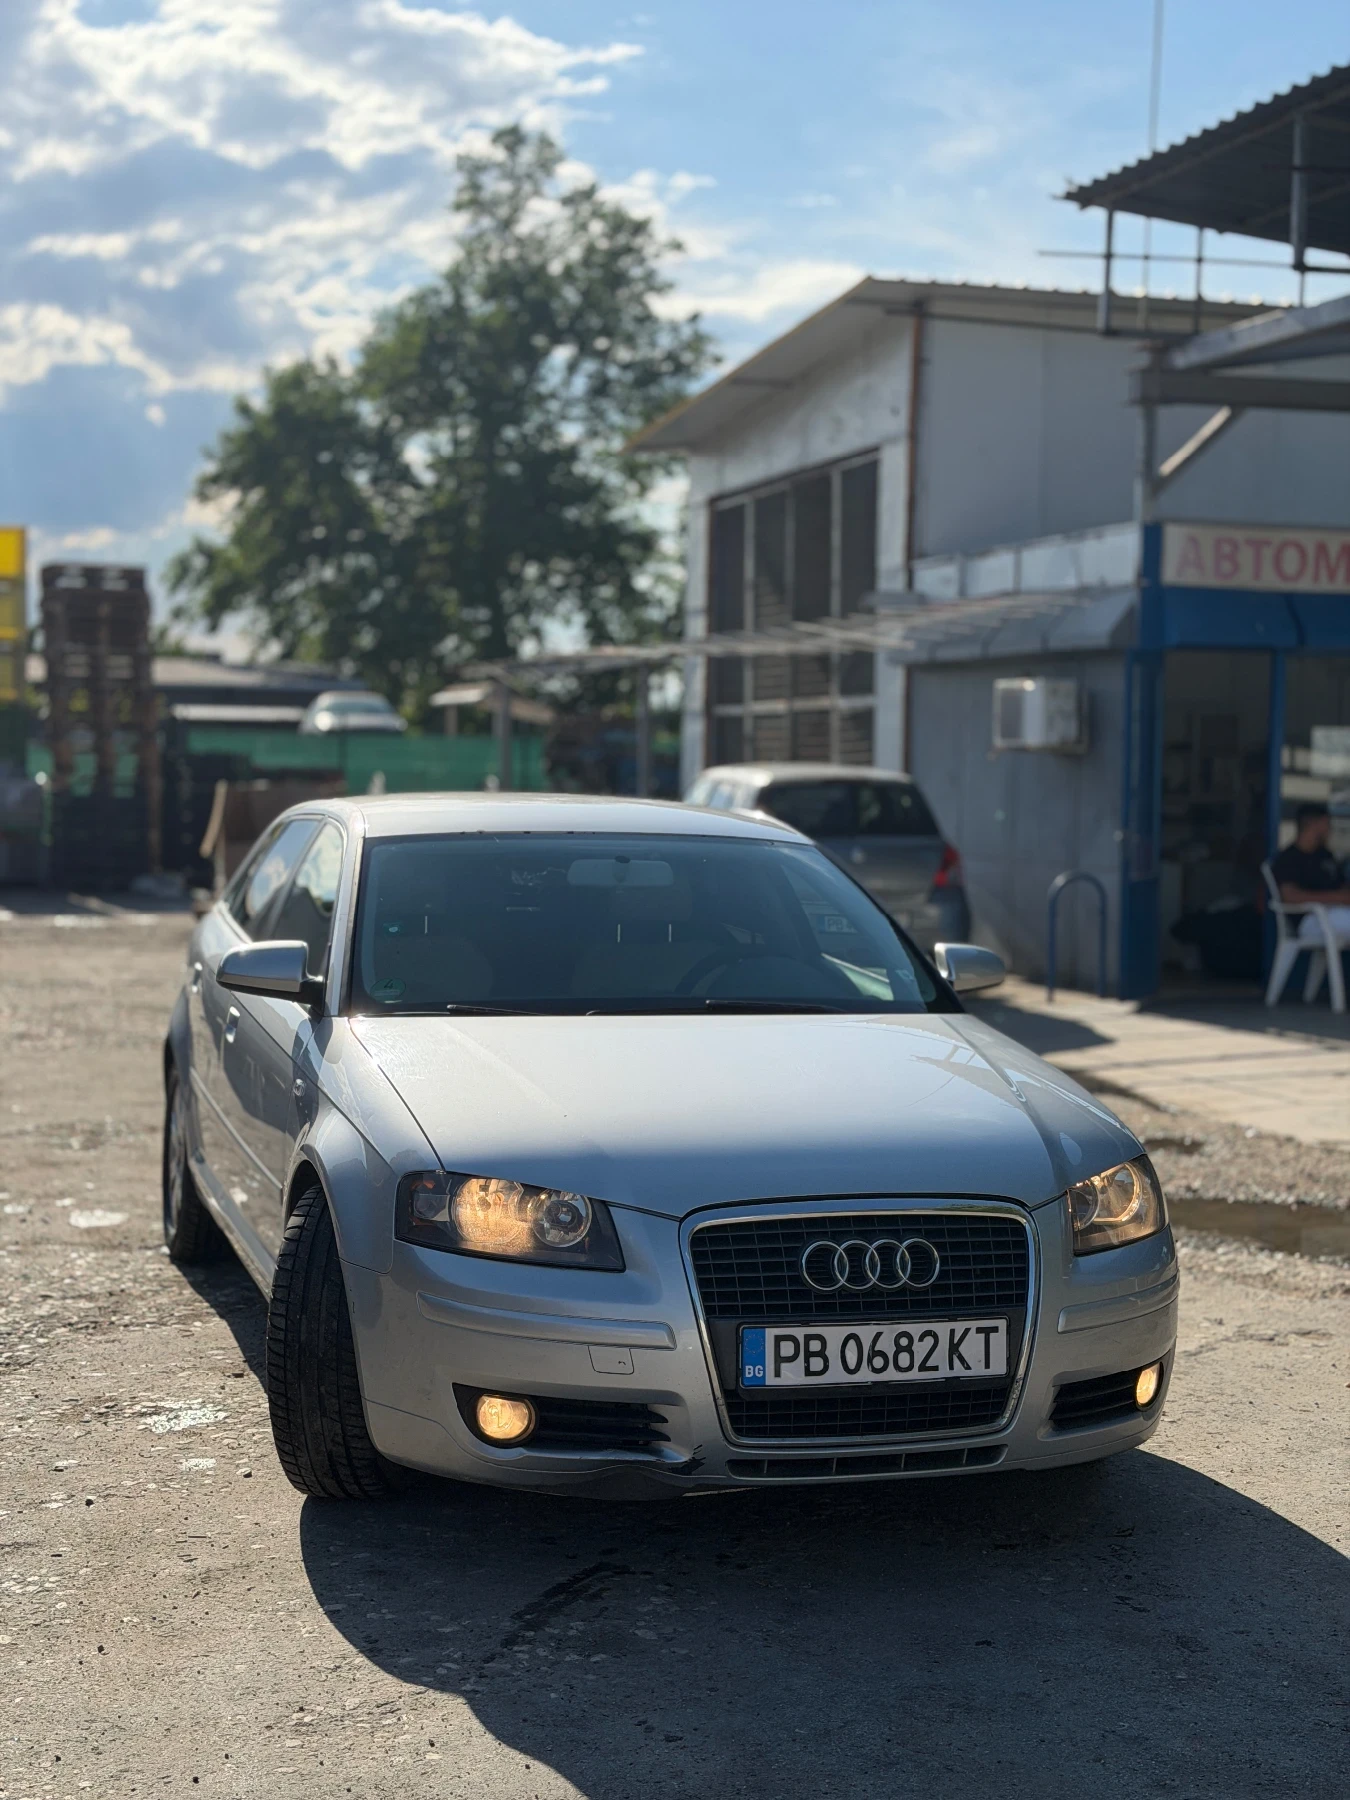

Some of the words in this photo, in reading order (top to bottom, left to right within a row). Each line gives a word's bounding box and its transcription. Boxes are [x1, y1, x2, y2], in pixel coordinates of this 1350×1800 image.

[773, 1334, 830, 1378] PB
[840, 1330, 940, 1375] 0682
[948, 1326, 999, 1371] KT
[745, 1365, 764, 1378] BG
